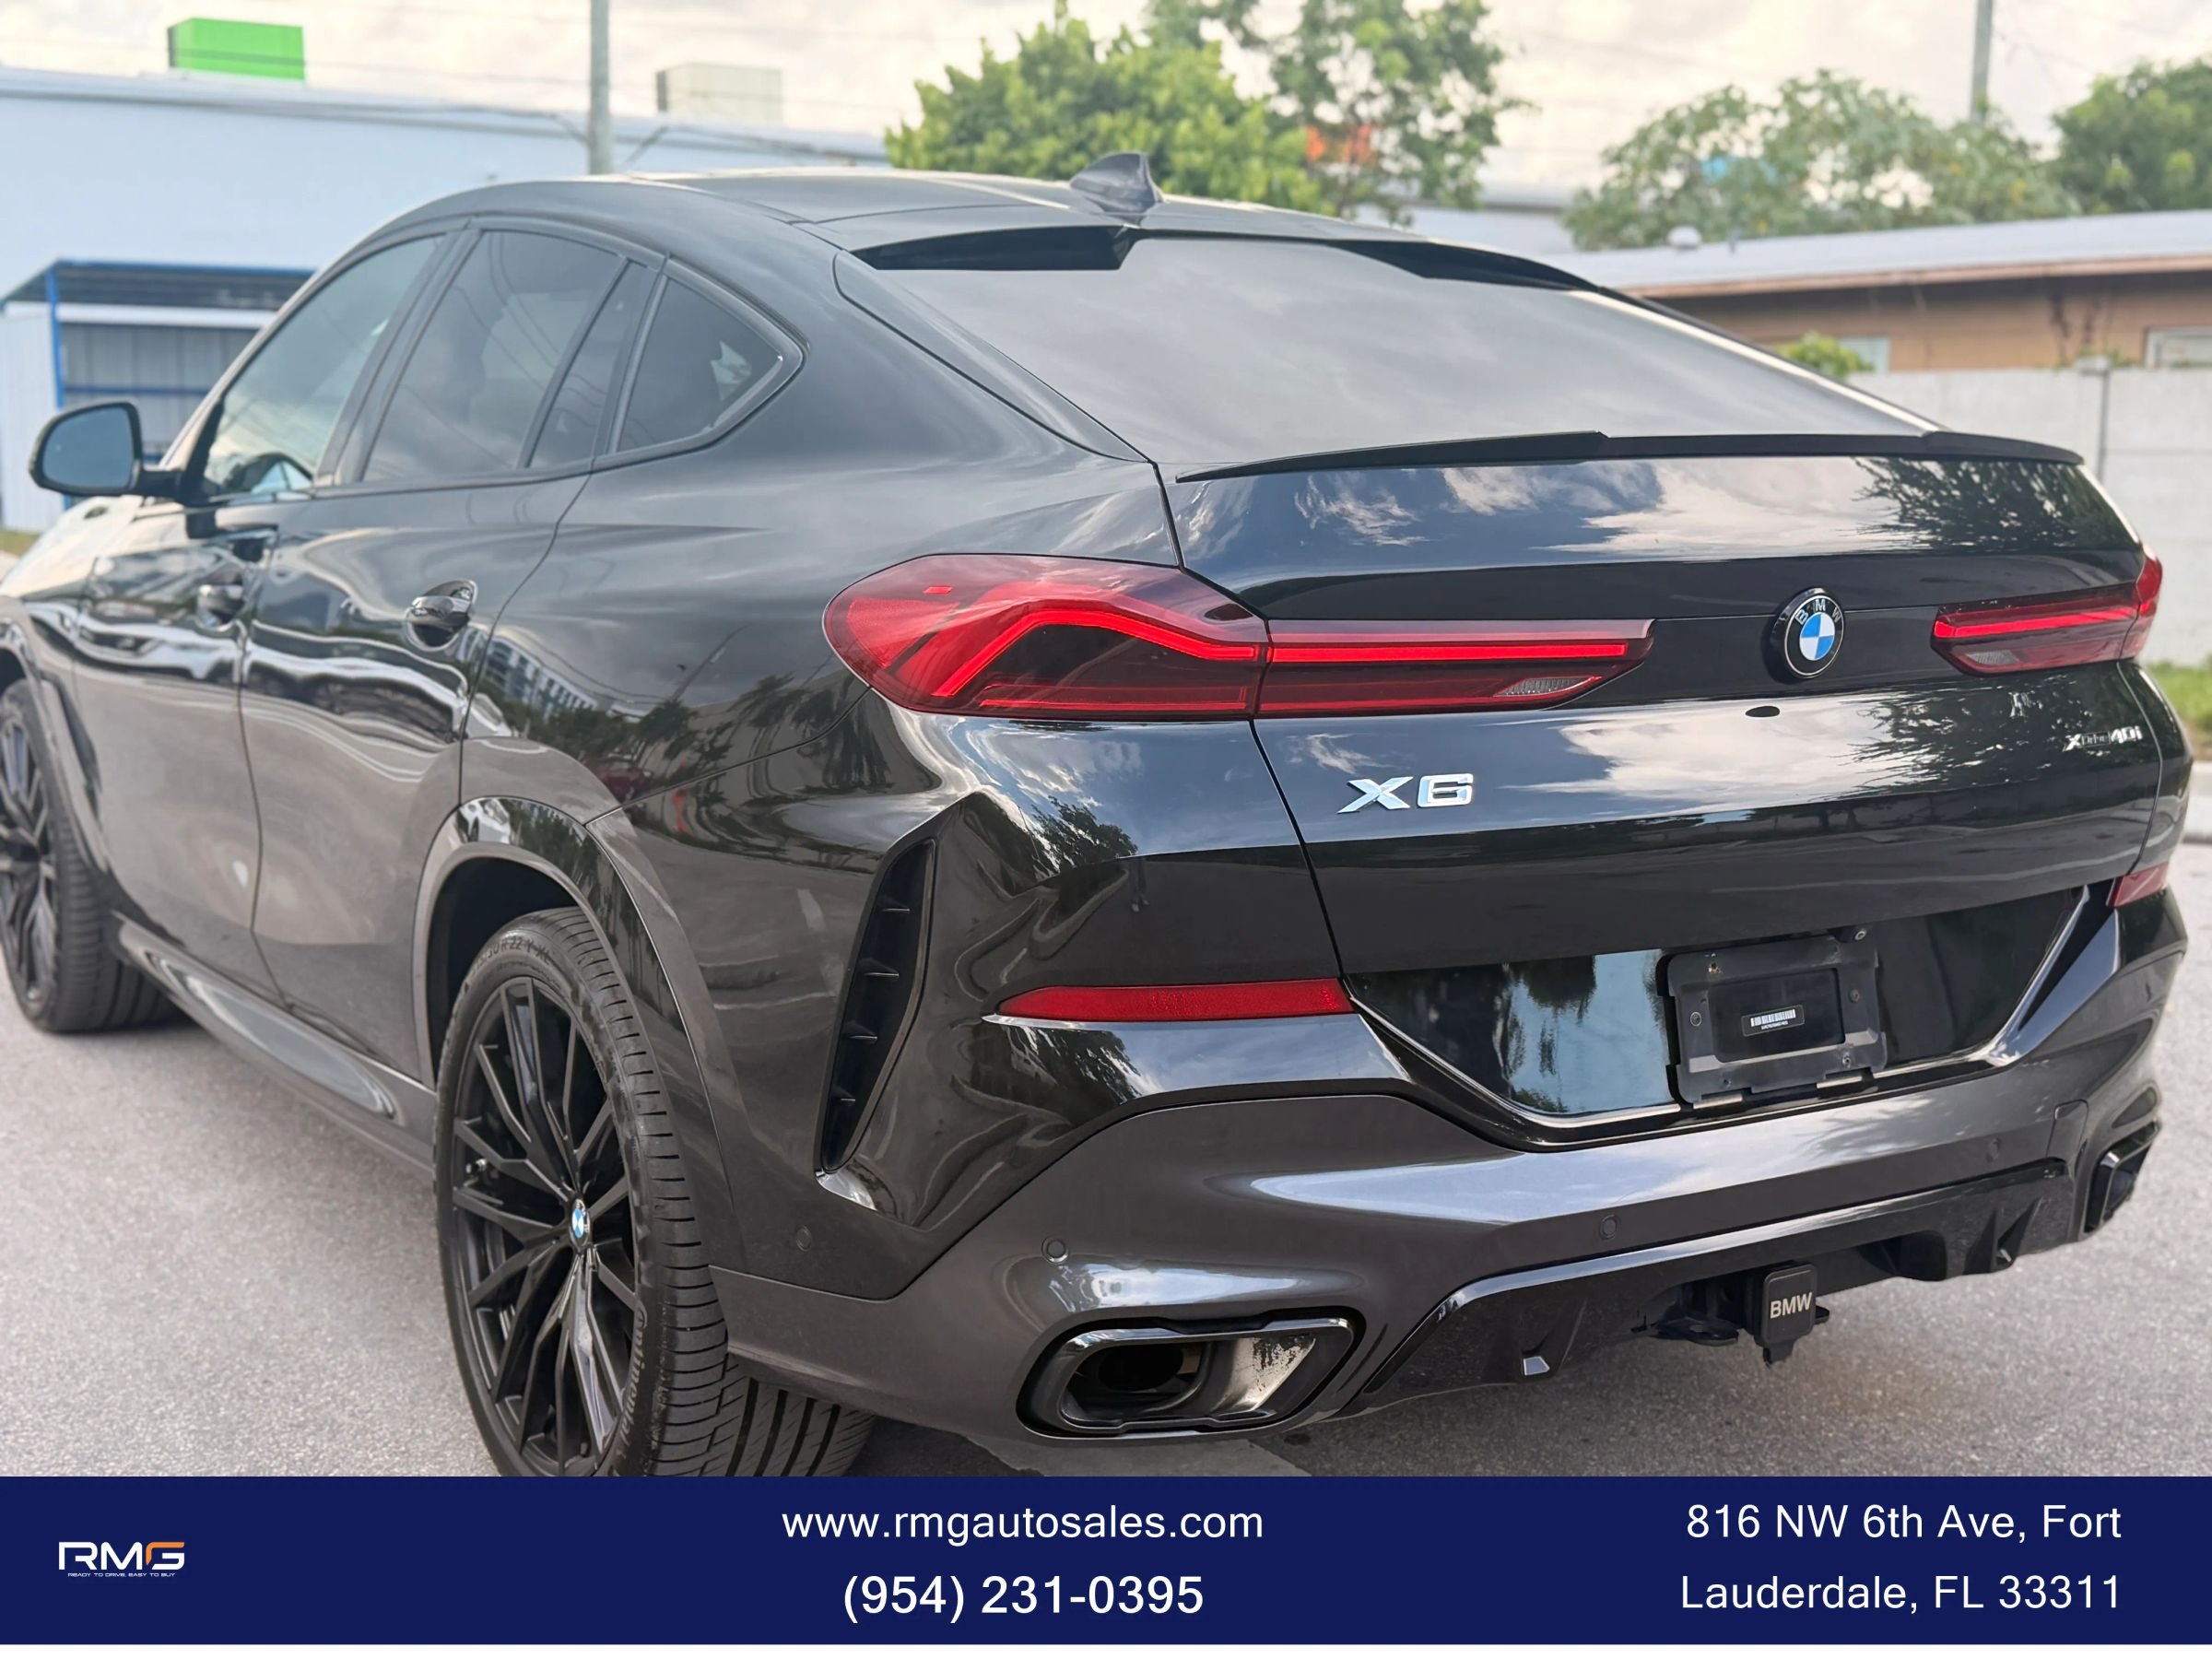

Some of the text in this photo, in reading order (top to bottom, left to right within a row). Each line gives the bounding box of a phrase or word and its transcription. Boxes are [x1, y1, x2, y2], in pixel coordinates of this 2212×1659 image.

[1794, 598, 1842, 626] BMW
[1336, 772, 1475, 814] X6
[1770, 1291, 1813, 1319] BMW
